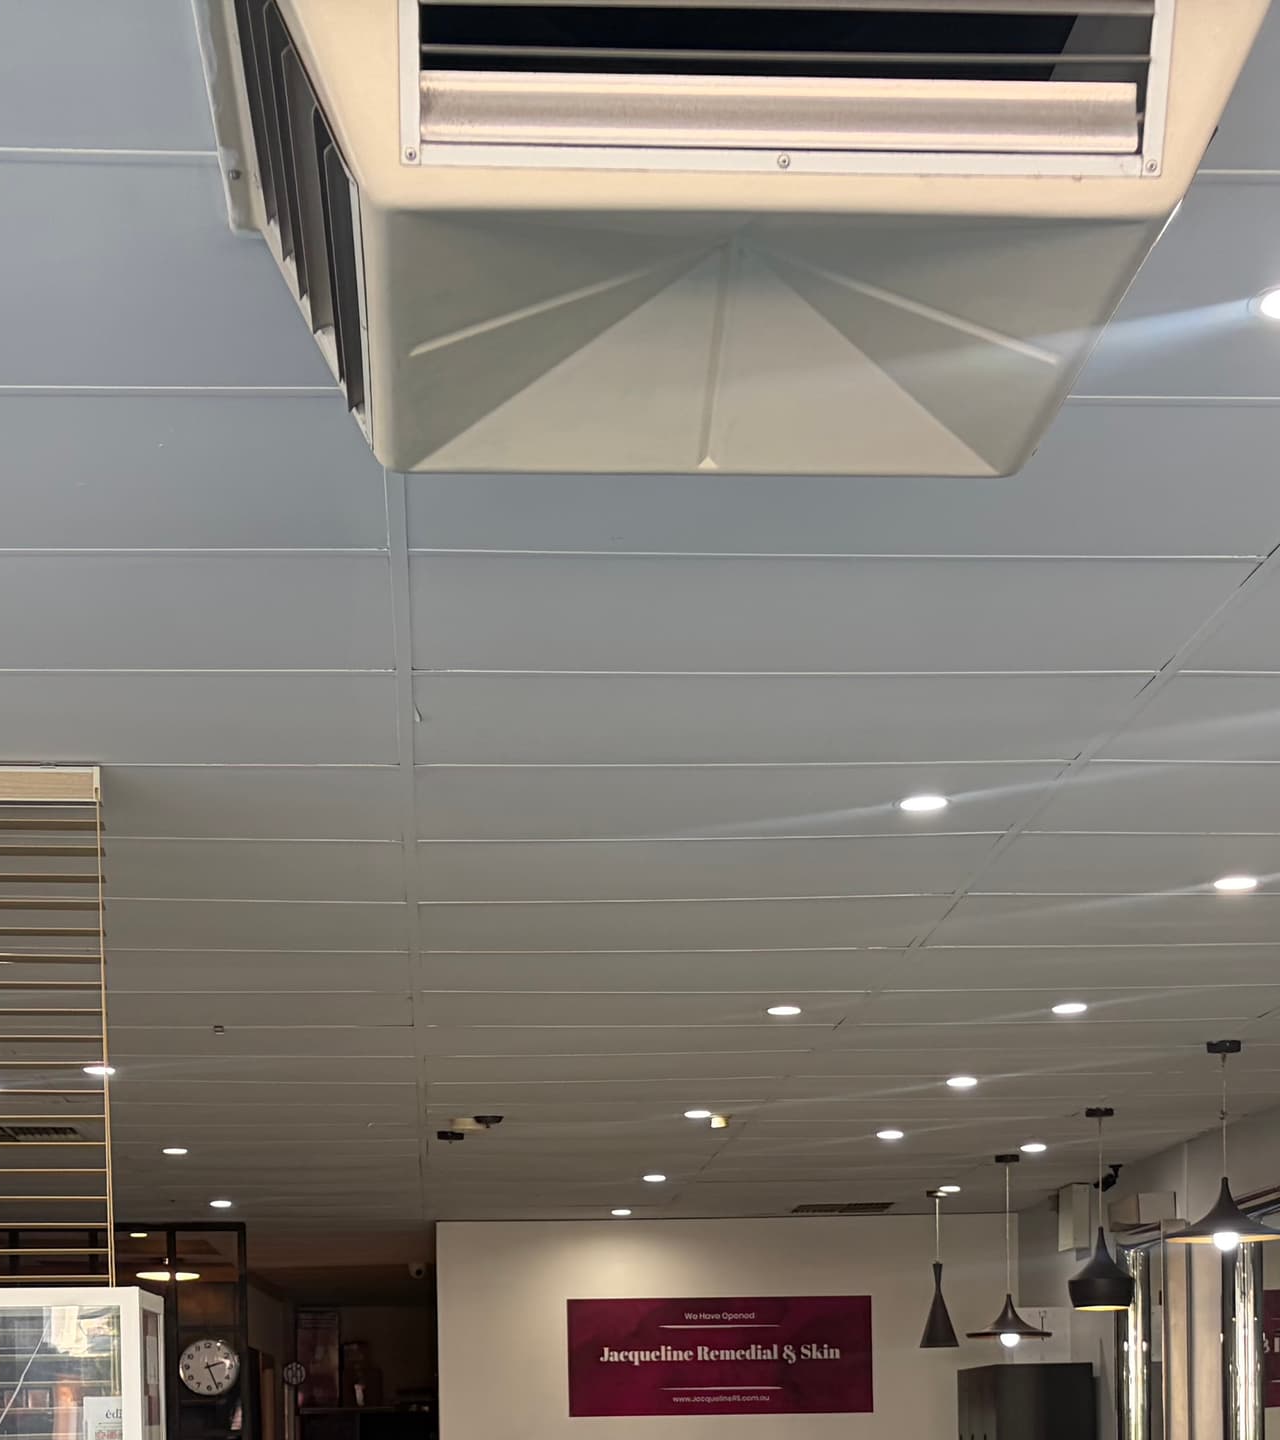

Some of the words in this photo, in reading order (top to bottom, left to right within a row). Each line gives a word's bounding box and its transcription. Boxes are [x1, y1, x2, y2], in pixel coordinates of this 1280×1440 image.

[684, 1312, 699, 1321] We
[699, 1312, 721, 1321] Have
[721, 1311, 756, 1321] Opened
[600, 1345, 694, 1367] Jacqueline
[696, 1344, 778, 1362] Remedial
[782, 1345, 797, 1364] &
[801, 1343, 841, 1361] Skin
